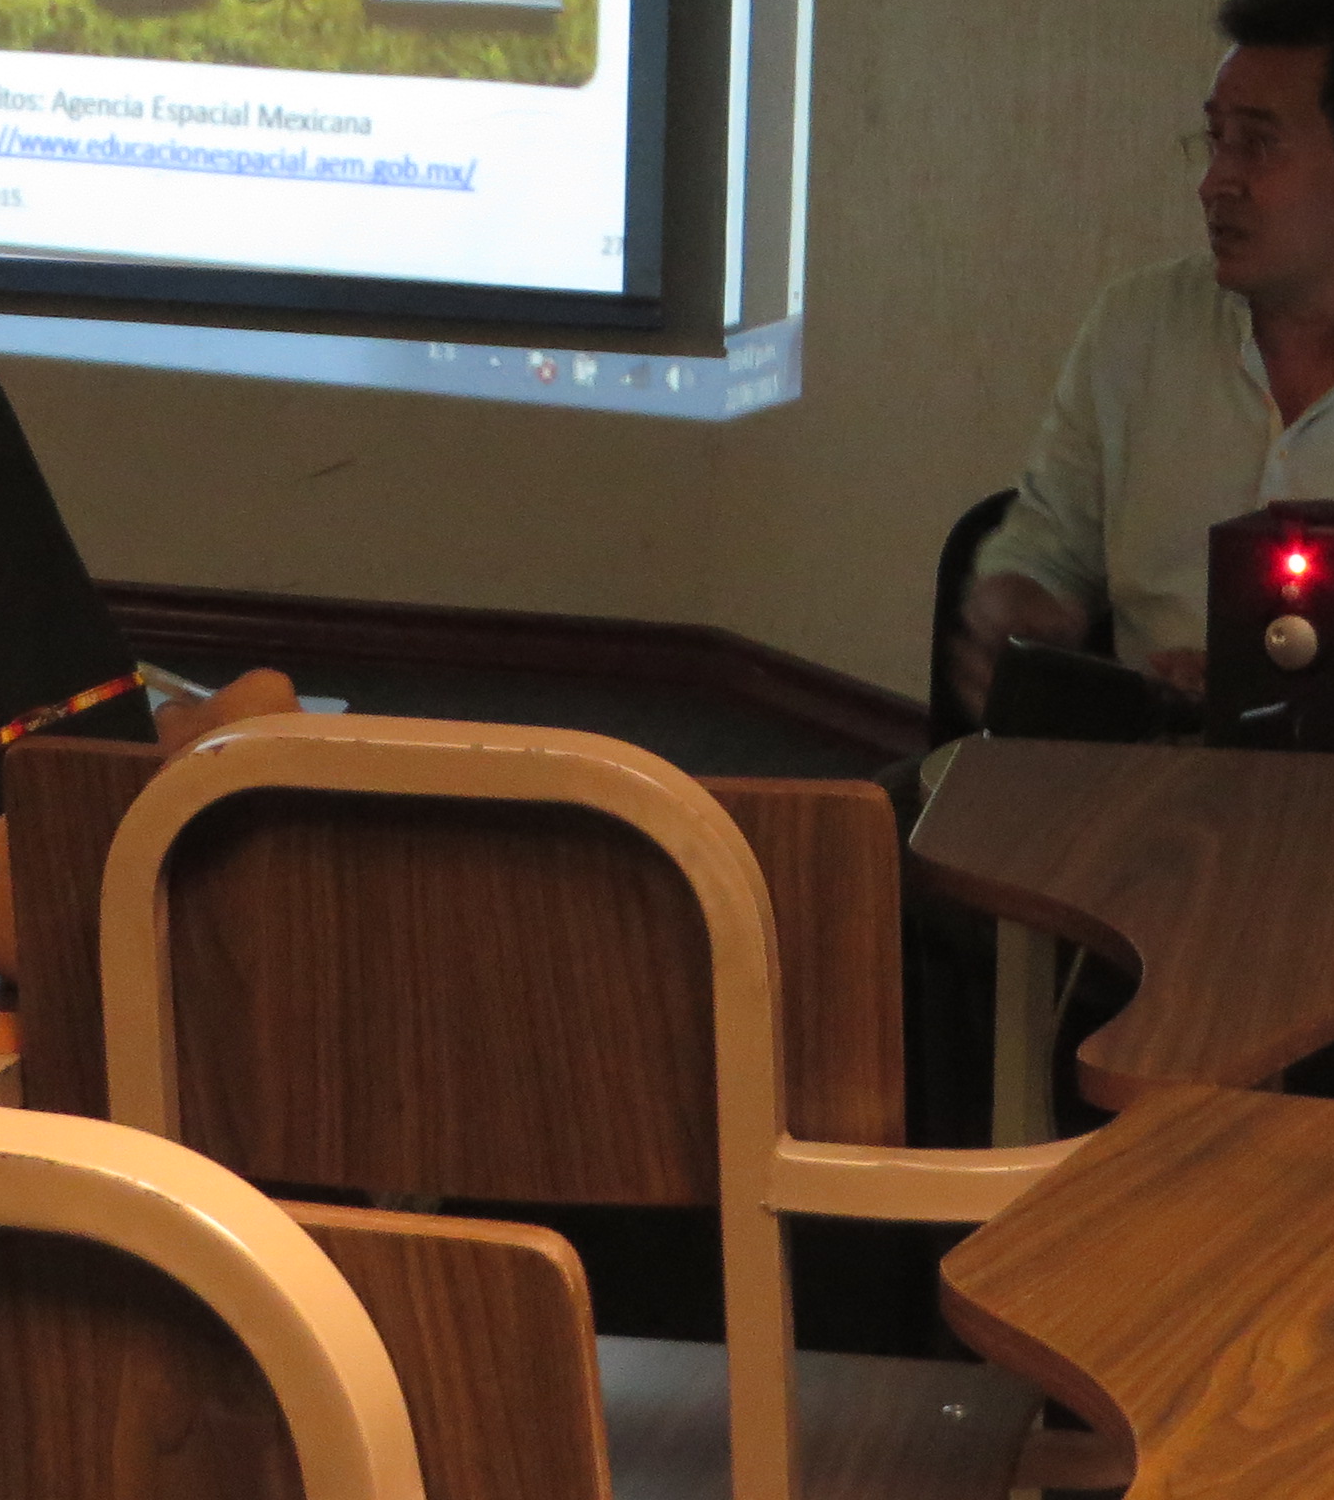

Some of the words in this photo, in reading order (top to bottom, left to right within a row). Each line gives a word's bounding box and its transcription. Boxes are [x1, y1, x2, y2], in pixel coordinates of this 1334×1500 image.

[52, 91, 144, 120] Agencia
[153, 96, 249, 127] Espacial
[258, 105, 373, 134] Mexicana
